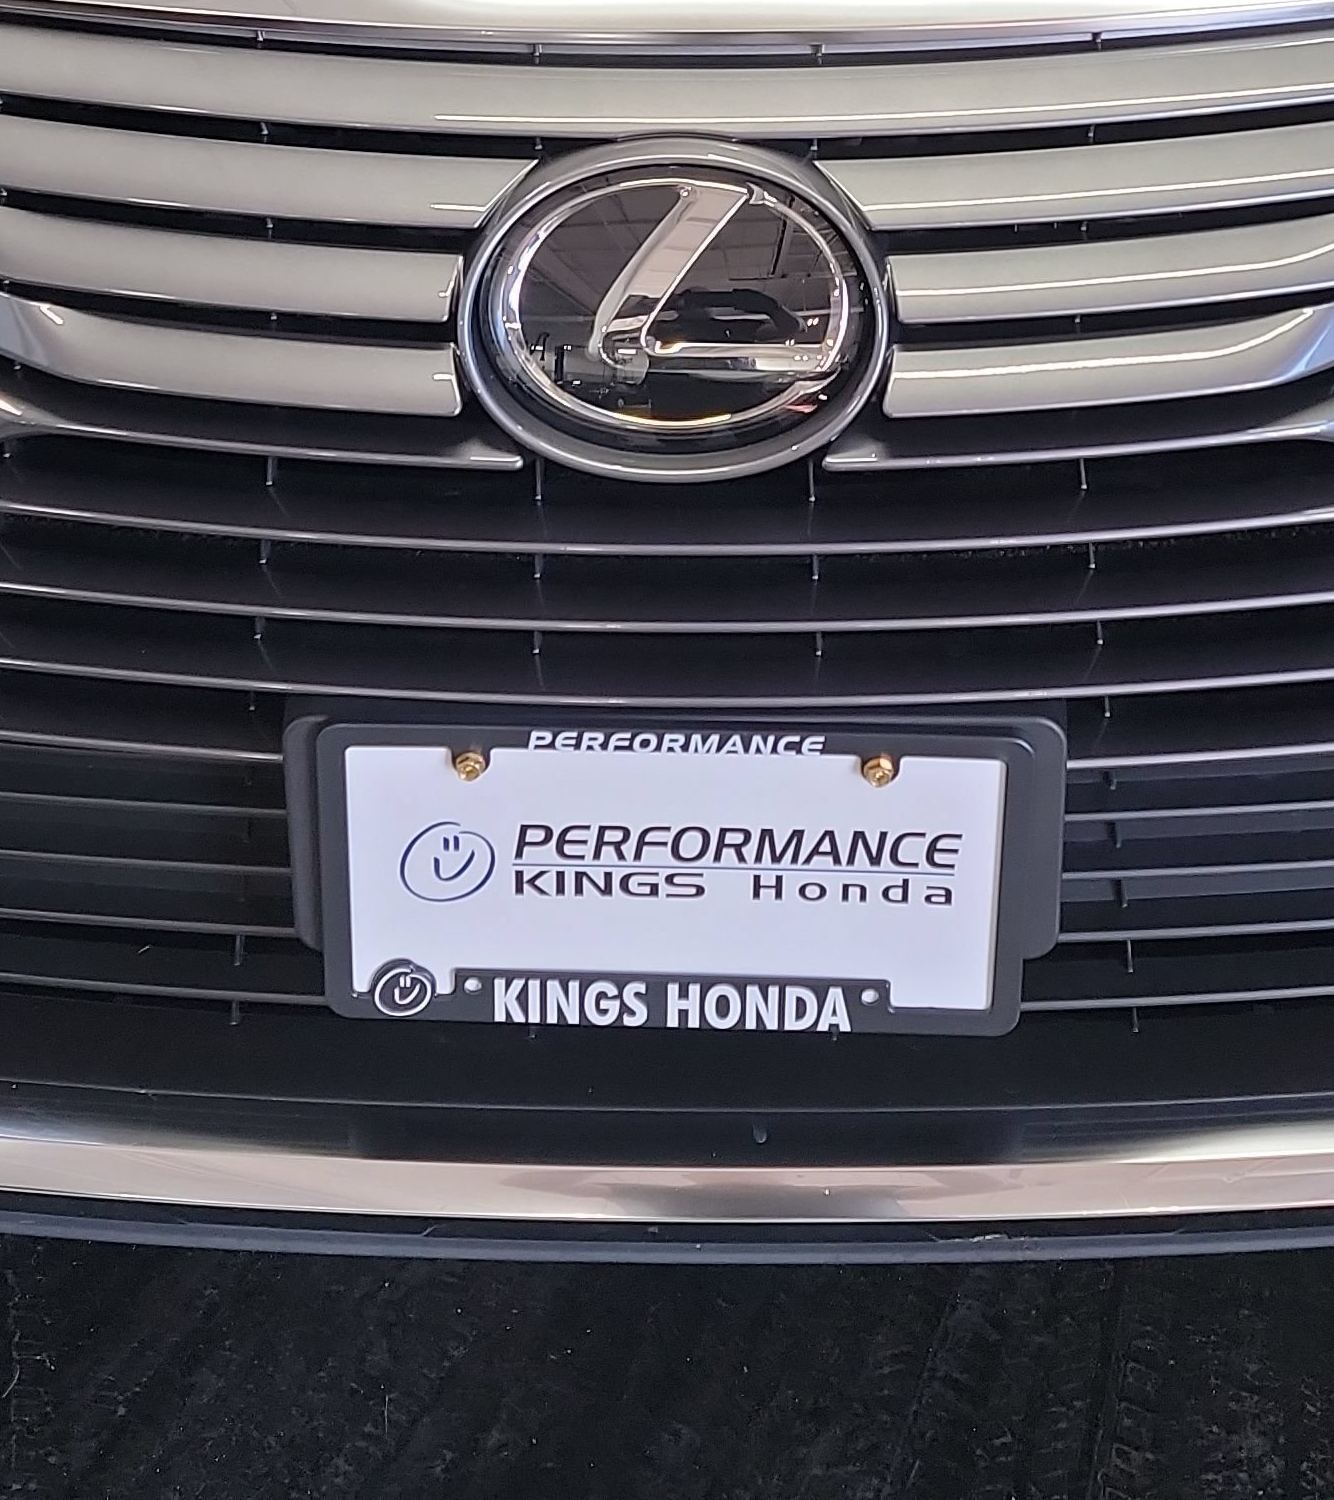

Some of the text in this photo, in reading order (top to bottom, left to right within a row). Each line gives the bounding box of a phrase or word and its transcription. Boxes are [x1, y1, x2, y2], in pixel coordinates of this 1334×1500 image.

[527, 729, 827, 755] PERFORMANCE
[513, 823, 964, 870] PERFORMANCE
[513, 869, 954, 906] KINGS Honda
[492, 976, 852, 1033] KINGS HONDA
